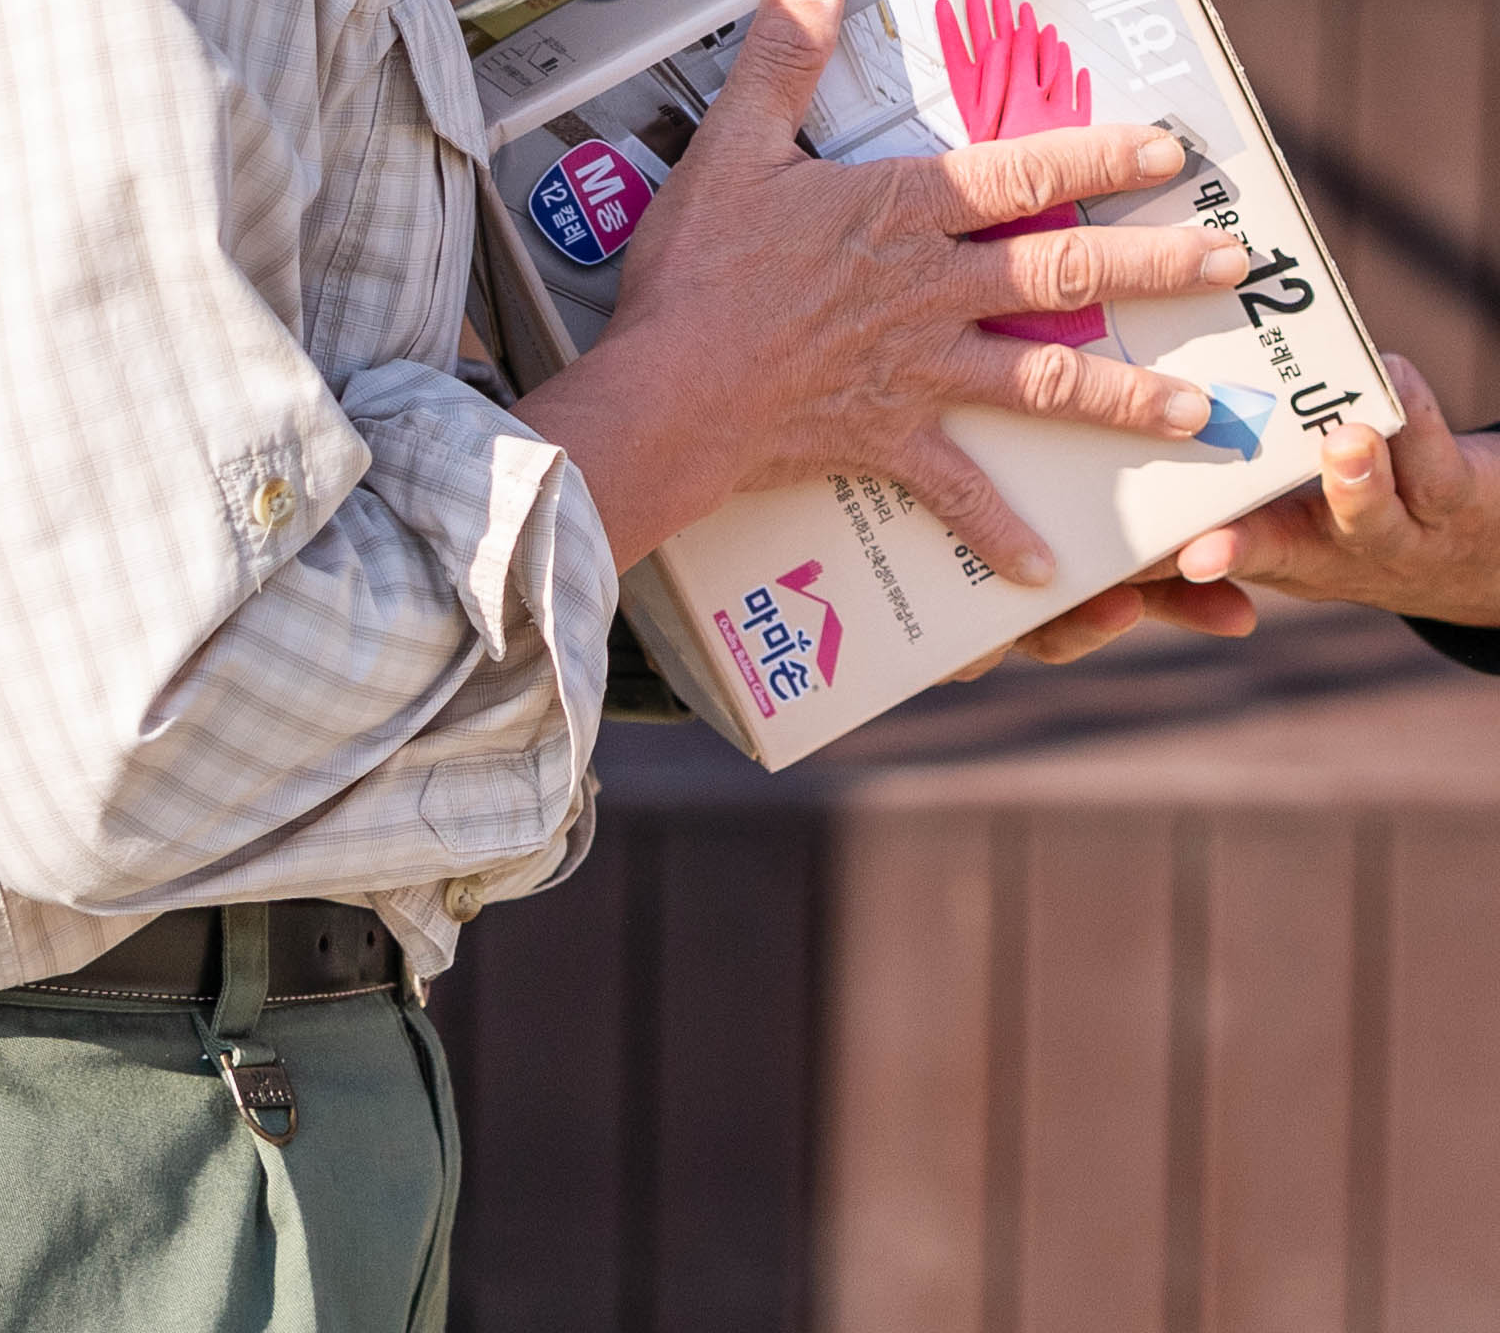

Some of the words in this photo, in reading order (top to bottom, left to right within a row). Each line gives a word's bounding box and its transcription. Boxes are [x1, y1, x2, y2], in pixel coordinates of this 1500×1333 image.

[540, 180, 568, 208] 12
[1234, 247, 1315, 329] 12
[843, 501, 875, 547] 유지하고
[743, 586, 811, 701] 마미손
